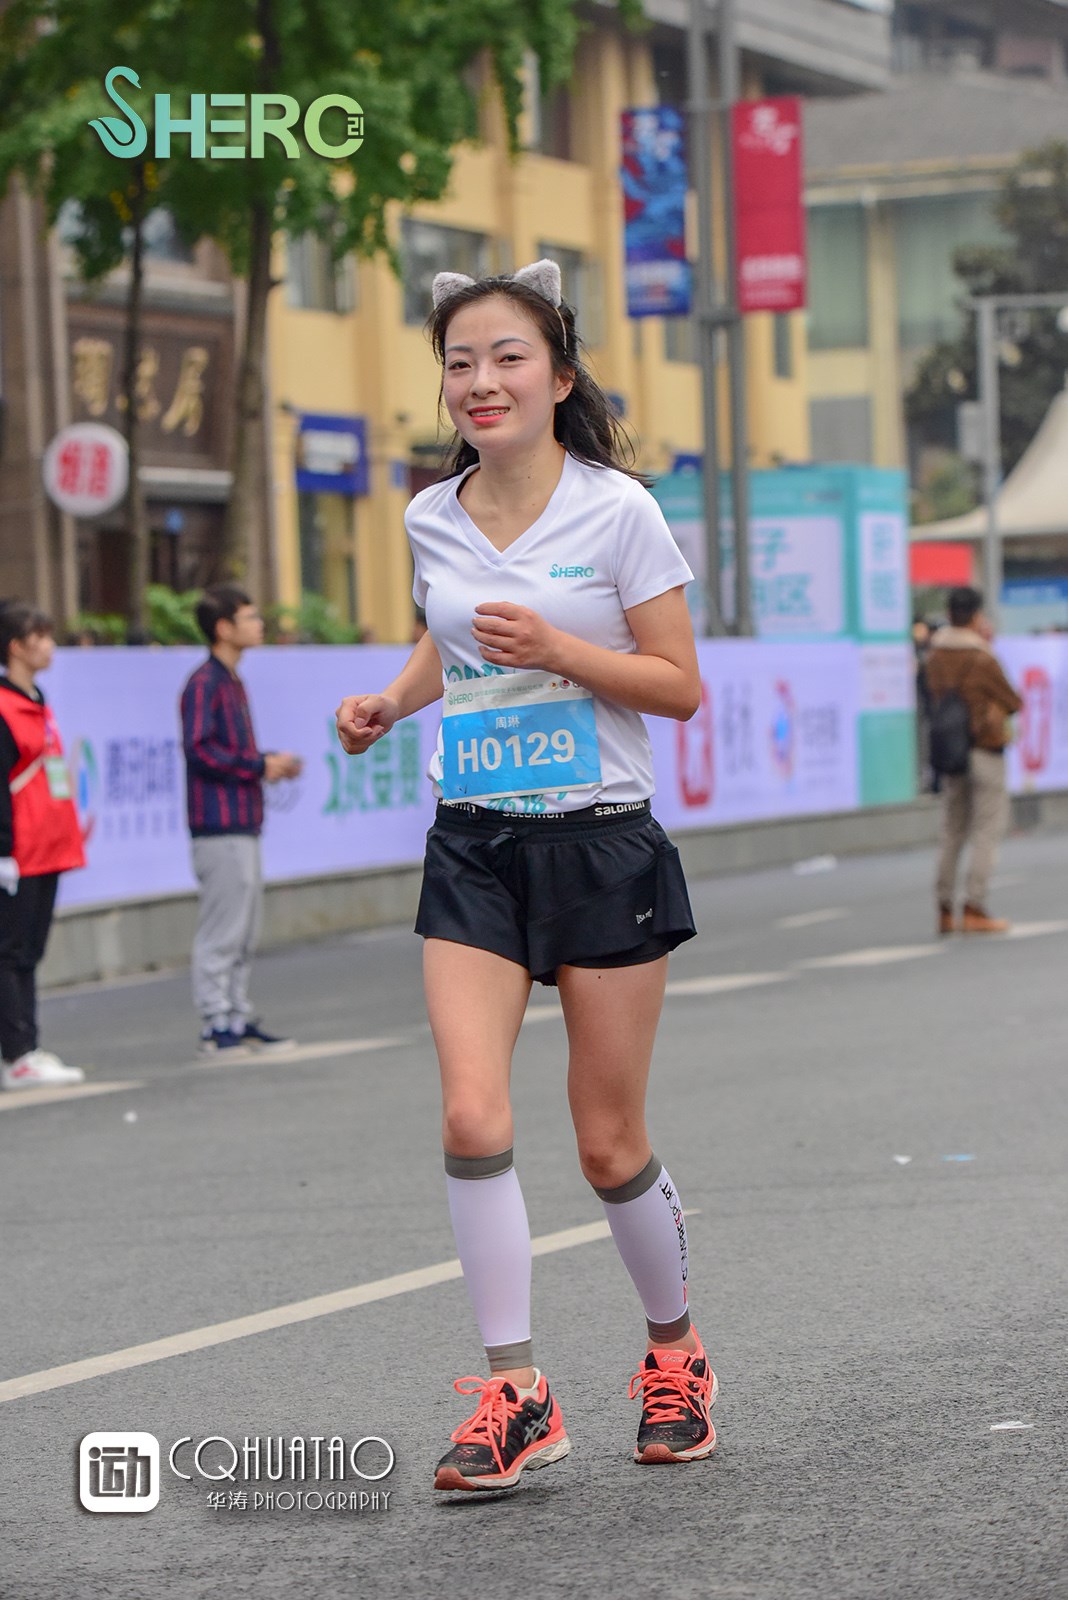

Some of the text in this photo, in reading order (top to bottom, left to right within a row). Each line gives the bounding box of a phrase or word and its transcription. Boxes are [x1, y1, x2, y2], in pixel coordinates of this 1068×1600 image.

[549, 563, 595, 578] SHERO
[448, 692, 473, 705] SHERO
[457, 729, 576, 775] H0129
